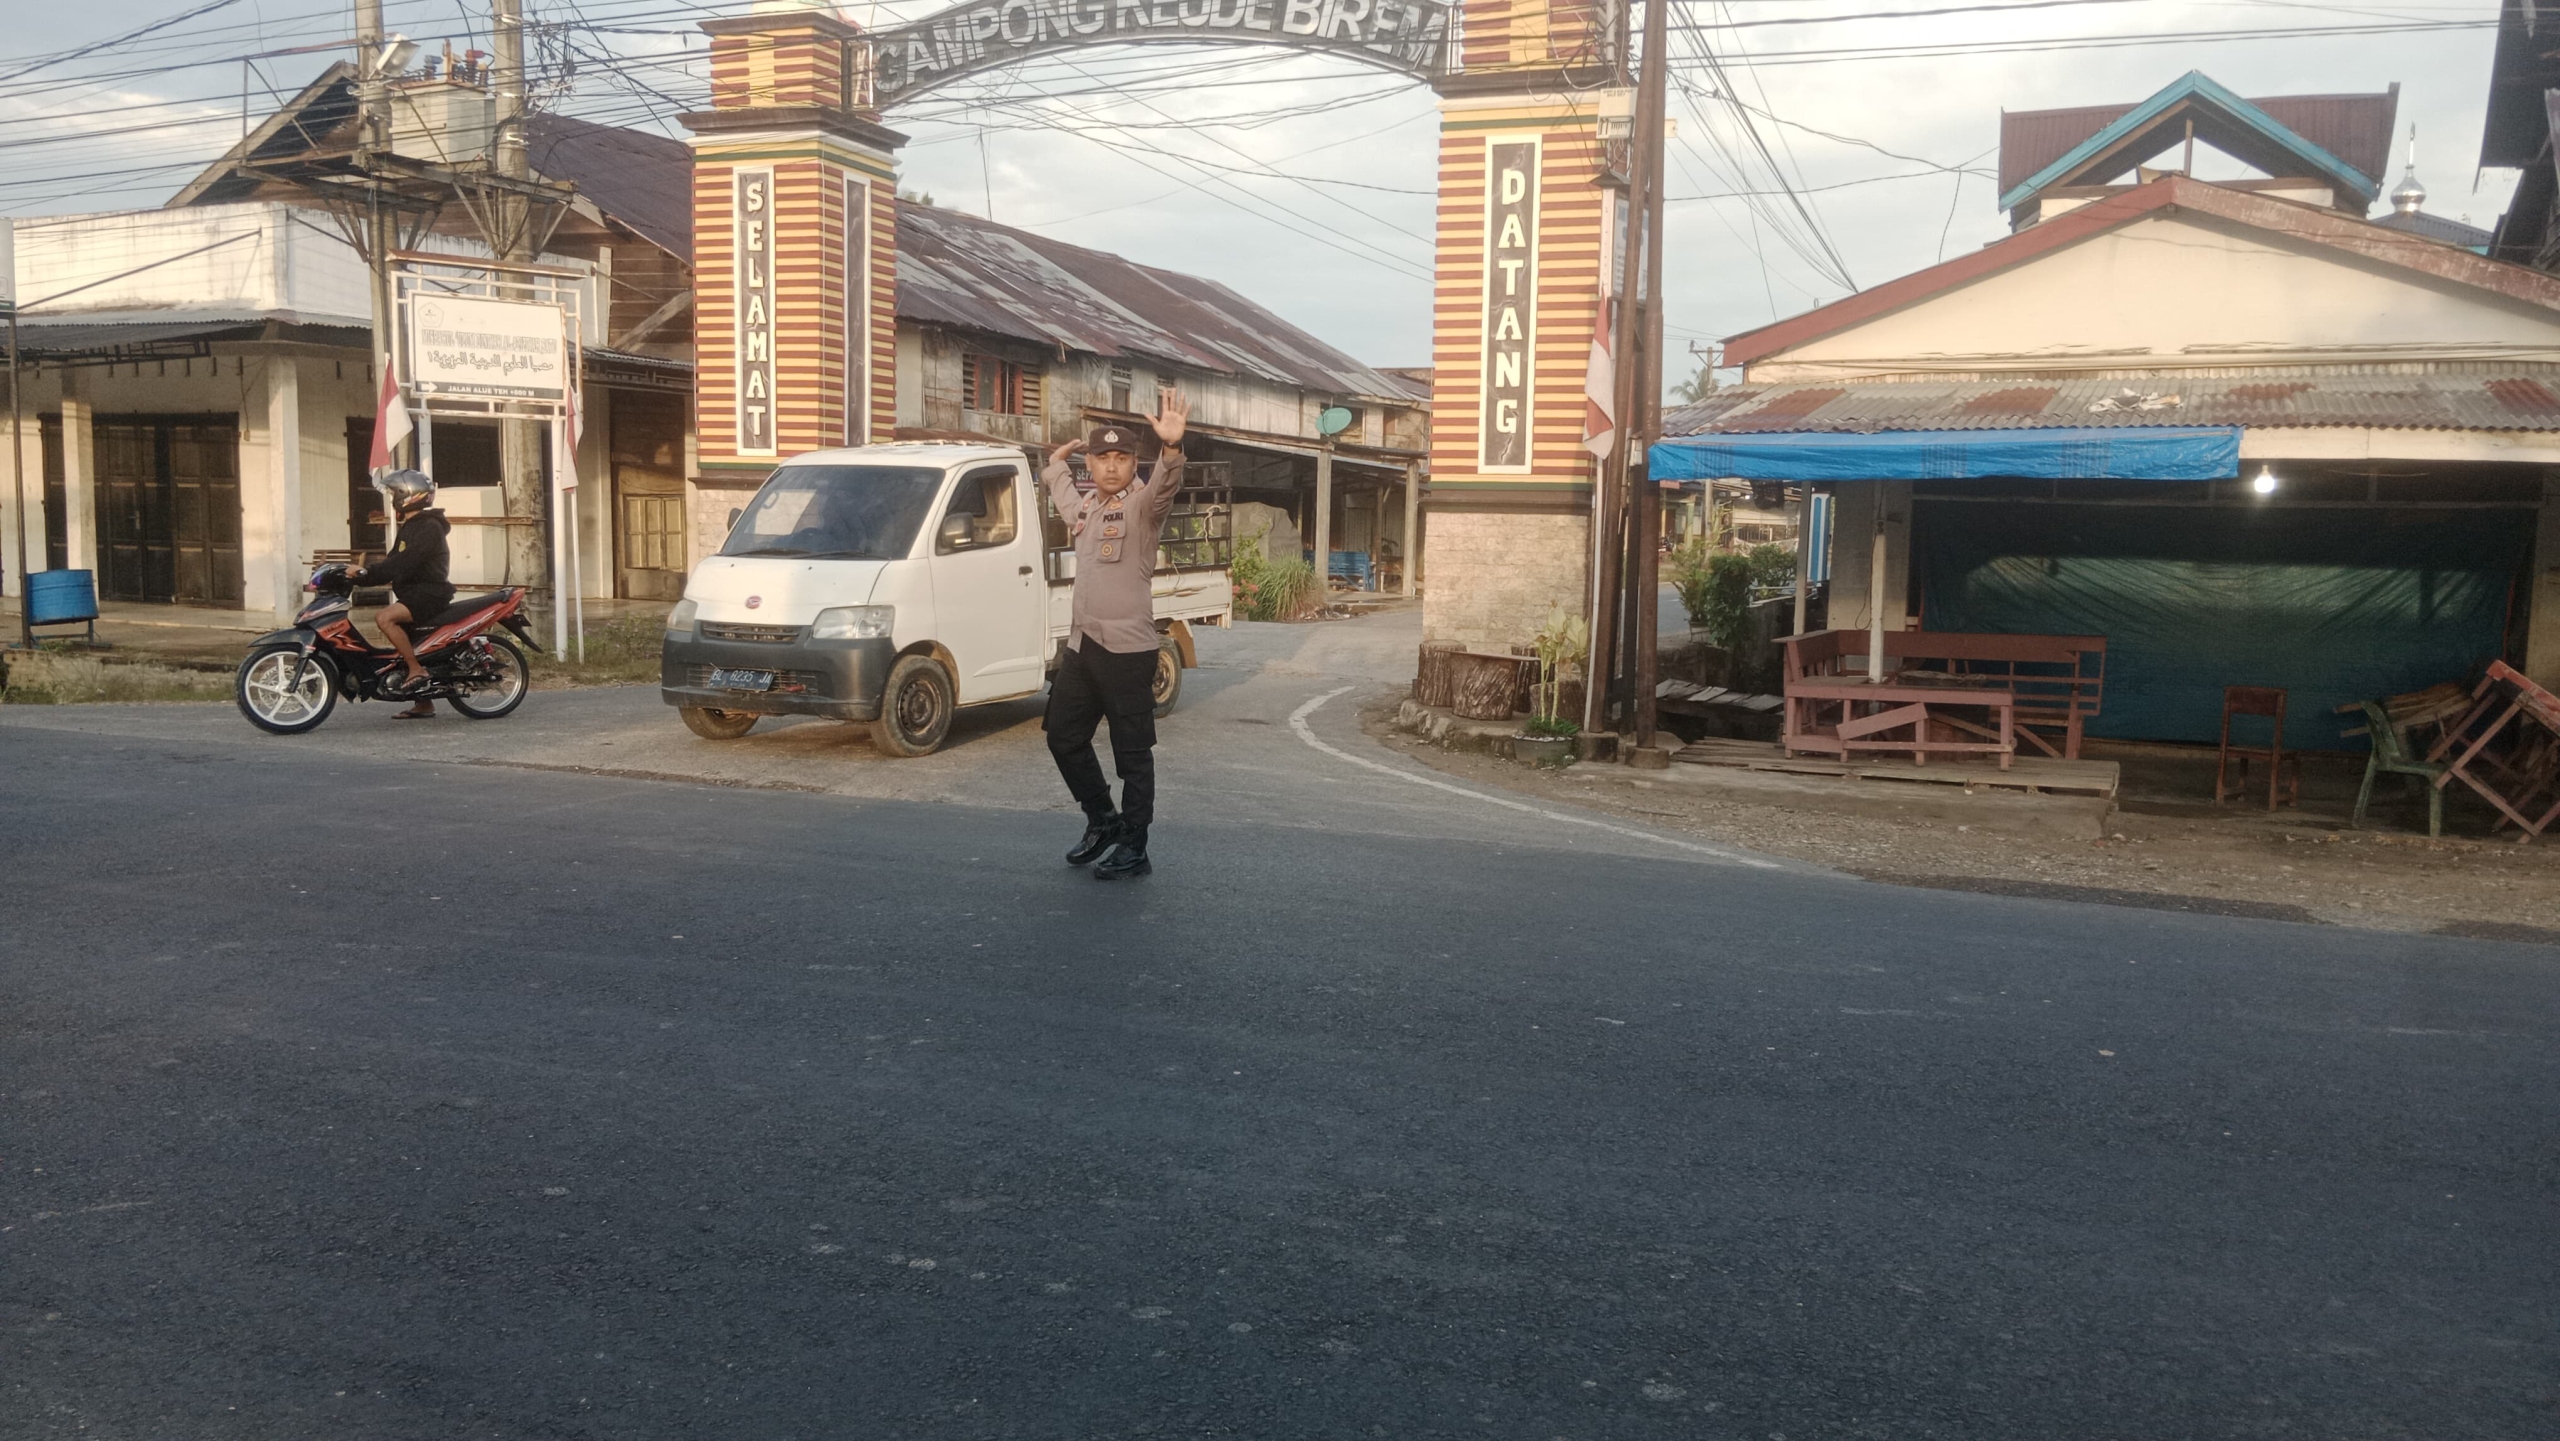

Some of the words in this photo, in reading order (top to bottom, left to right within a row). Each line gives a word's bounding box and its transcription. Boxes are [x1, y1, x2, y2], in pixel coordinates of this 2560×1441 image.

[873, 0, 1104, 92] GAMPONG
[1282, 0, 1447, 67] BIREM
[746, 182, 768, 436] SELAMAT
[1495, 168, 1526, 434] DATANG
[448, 385, 471, 393] JALAN
[1103, 512, 1123, 522] POLRI
[712, 669, 724, 681] BL
